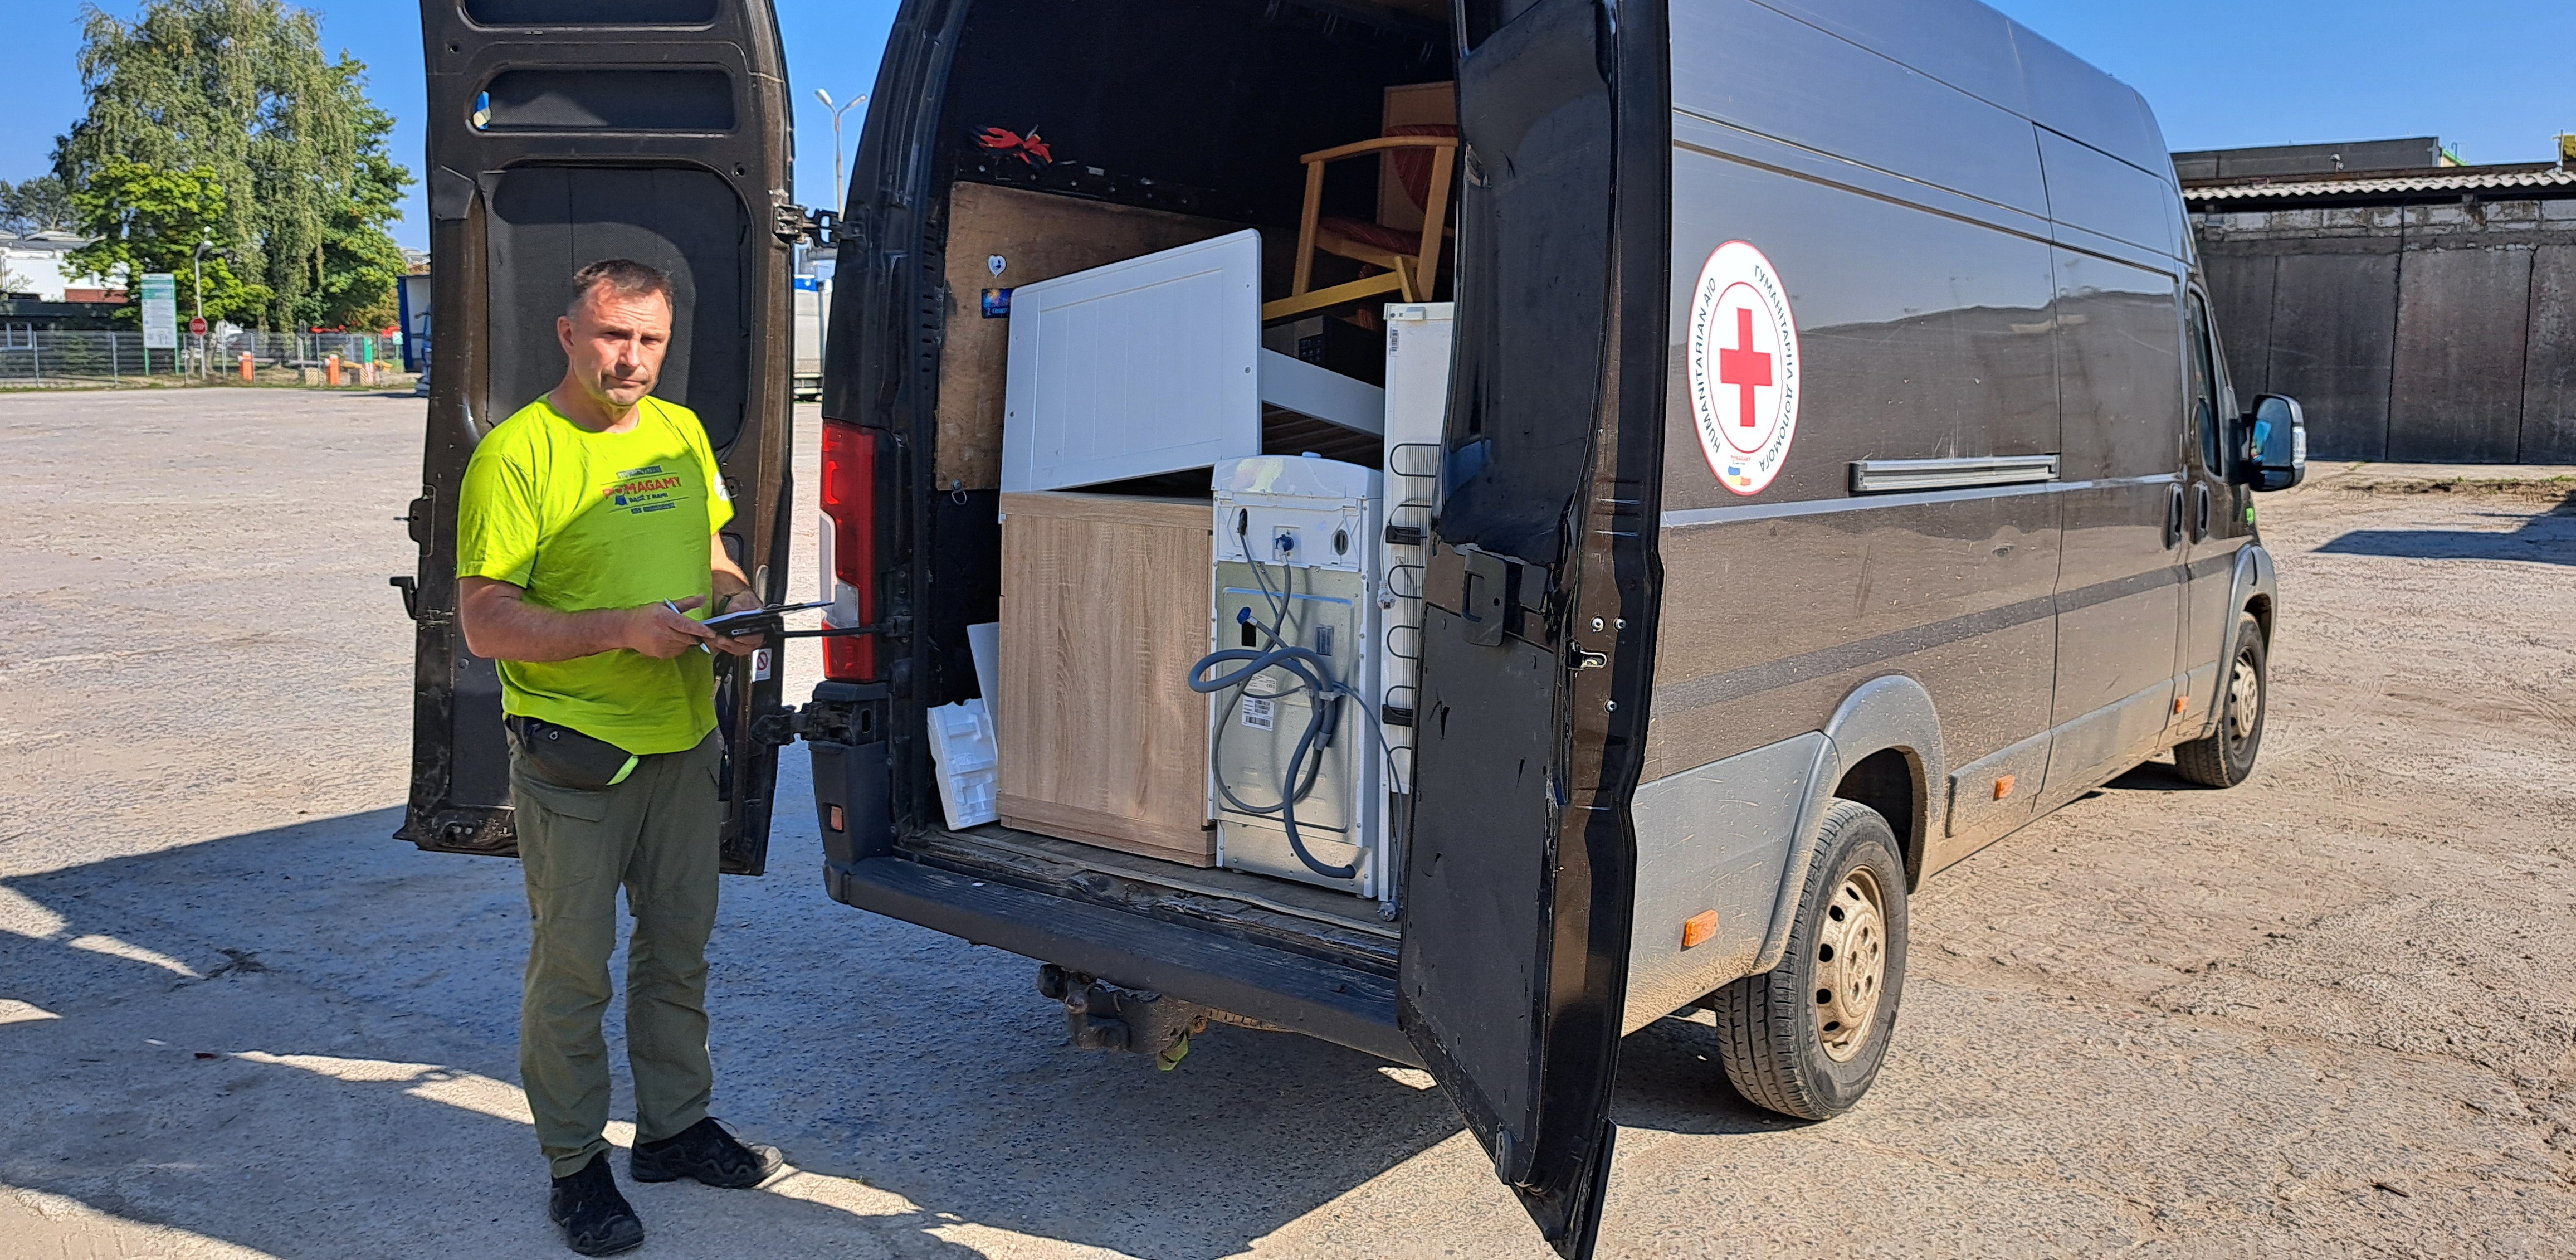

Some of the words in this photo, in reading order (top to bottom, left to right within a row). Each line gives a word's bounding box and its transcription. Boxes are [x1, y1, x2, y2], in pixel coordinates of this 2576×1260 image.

[1704, 278, 1715, 307] AID
[1754, 265, 1793, 380] ГУМАНІТАРНА
[1695, 307, 1720, 454] HUMANITARIAN
[1759, 383, 1793, 472] ДОПОМОГА
